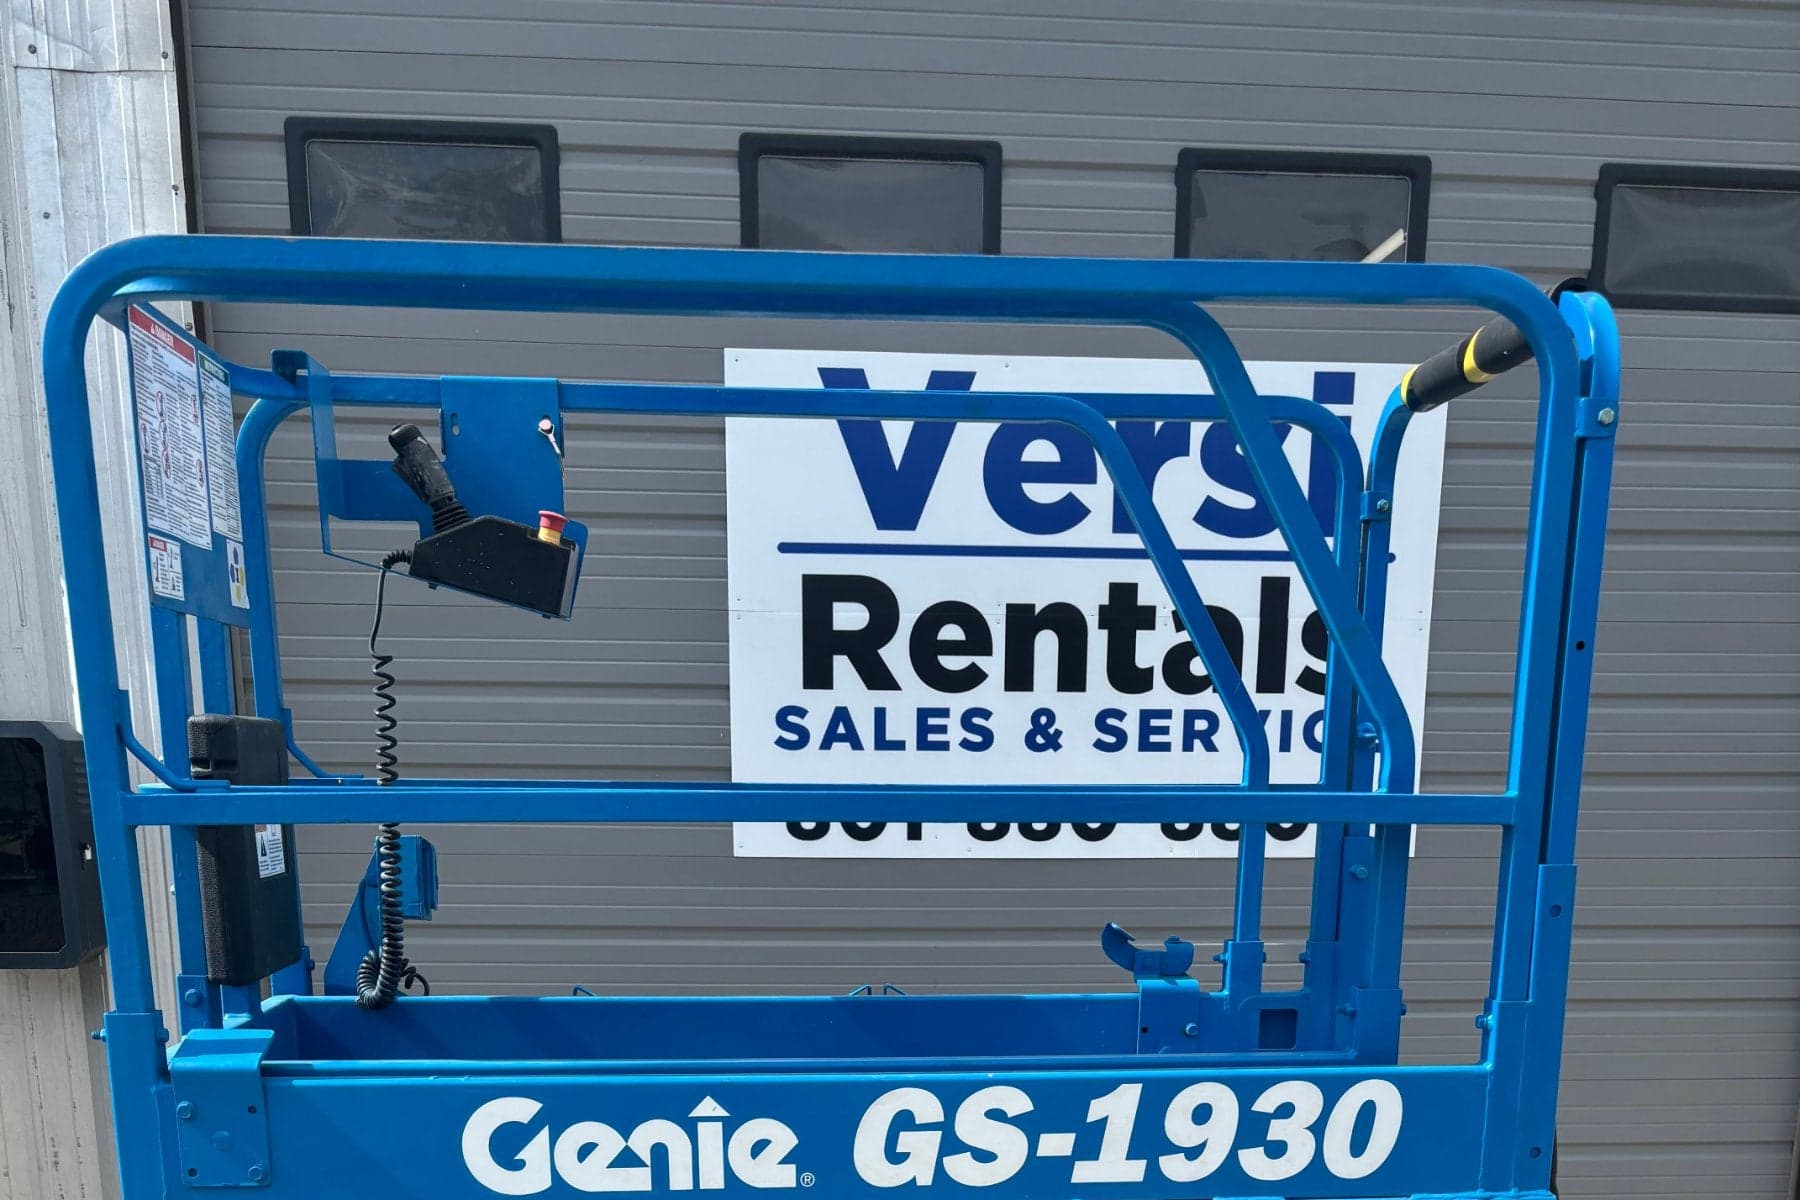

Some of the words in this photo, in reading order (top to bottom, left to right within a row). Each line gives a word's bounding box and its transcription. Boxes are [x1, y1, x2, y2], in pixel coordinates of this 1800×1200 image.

[817, 367, 1356, 539] Versi
[773, 705, 994, 752] SALES
[1024, 707, 1063, 753] &
[1092, 708, 1325, 753] SERIC
[461, 1095, 799, 1195] Genie
[853, 1079, 1403, 1187] GS-1930
